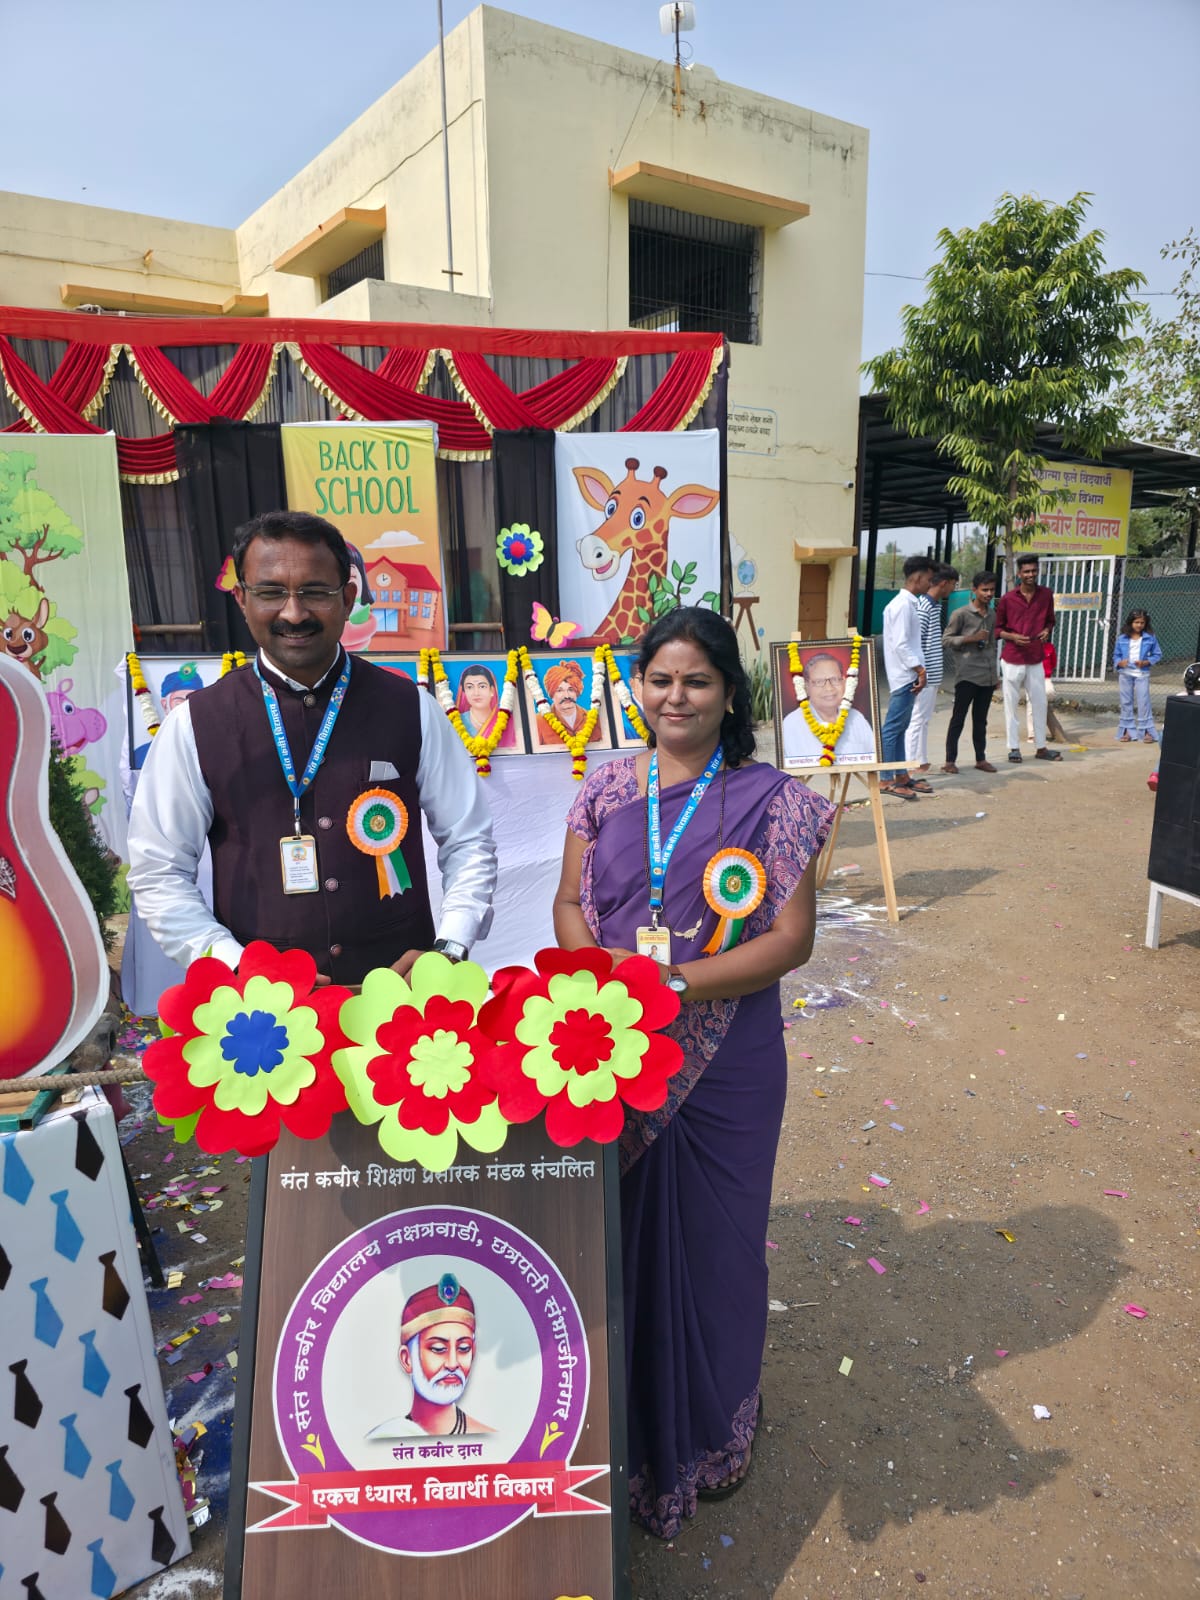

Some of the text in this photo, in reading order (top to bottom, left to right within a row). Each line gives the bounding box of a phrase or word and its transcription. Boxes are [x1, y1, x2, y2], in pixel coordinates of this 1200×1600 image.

[319, 440, 410, 472] BACK TO
[315, 476, 420, 515] SCHOOL
[1075, 509, 1121, 539] विद्यालय
[280, 1164, 309, 1191] संत
[314, 1164, 361, 1188] कबीर
[366, 1163, 417, 1188] शिक्षण
[486, 1157, 525, 1181] मंडळ
[531, 1155, 595, 1181] संचलित
[289, 1220, 578, 1433] संत कबीर विद्यालय नक्षत्रवाडी, छत्रपती संभाजीनगर
[393, 1443, 414, 1460] संत
[457, 1443, 483, 1460] दास
[312, 1473, 555, 1508] एकच ध्यास, विद्यार्थी विकास
